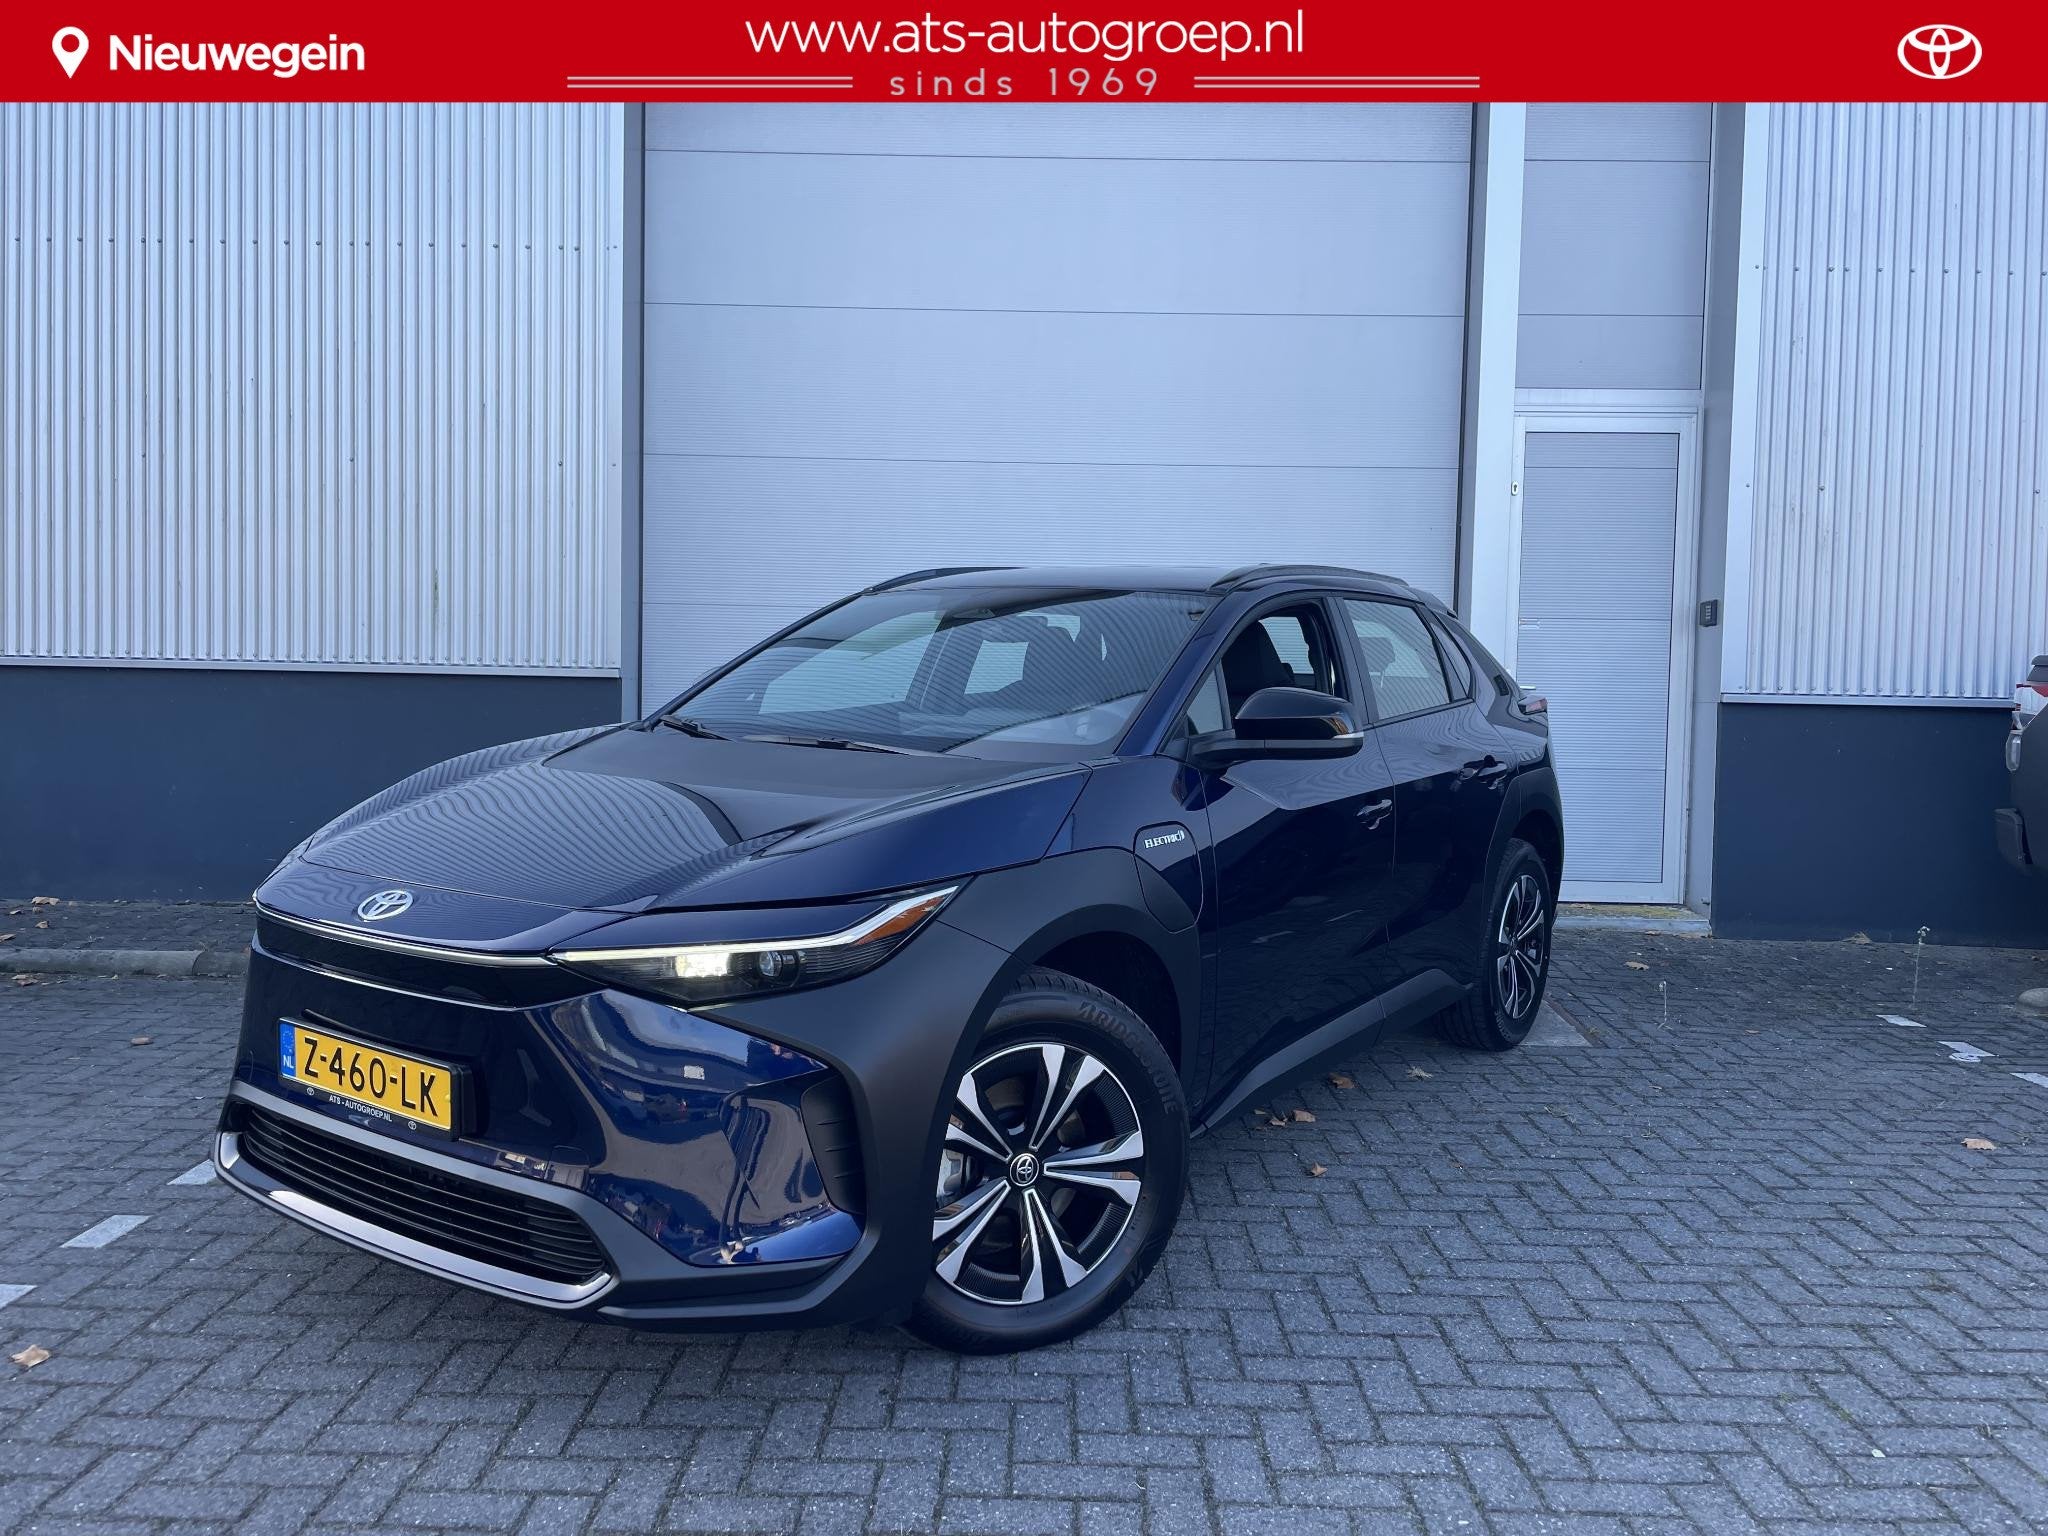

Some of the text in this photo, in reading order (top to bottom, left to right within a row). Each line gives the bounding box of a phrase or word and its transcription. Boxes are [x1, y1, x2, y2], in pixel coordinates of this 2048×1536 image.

[283, 1055, 294, 1069] NL
[304, 1037, 438, 1117] Z-460-LK
[329, 1094, 341, 1105] ATS
[344, 1099, 393, 1122] AUTOGROEP.NL
